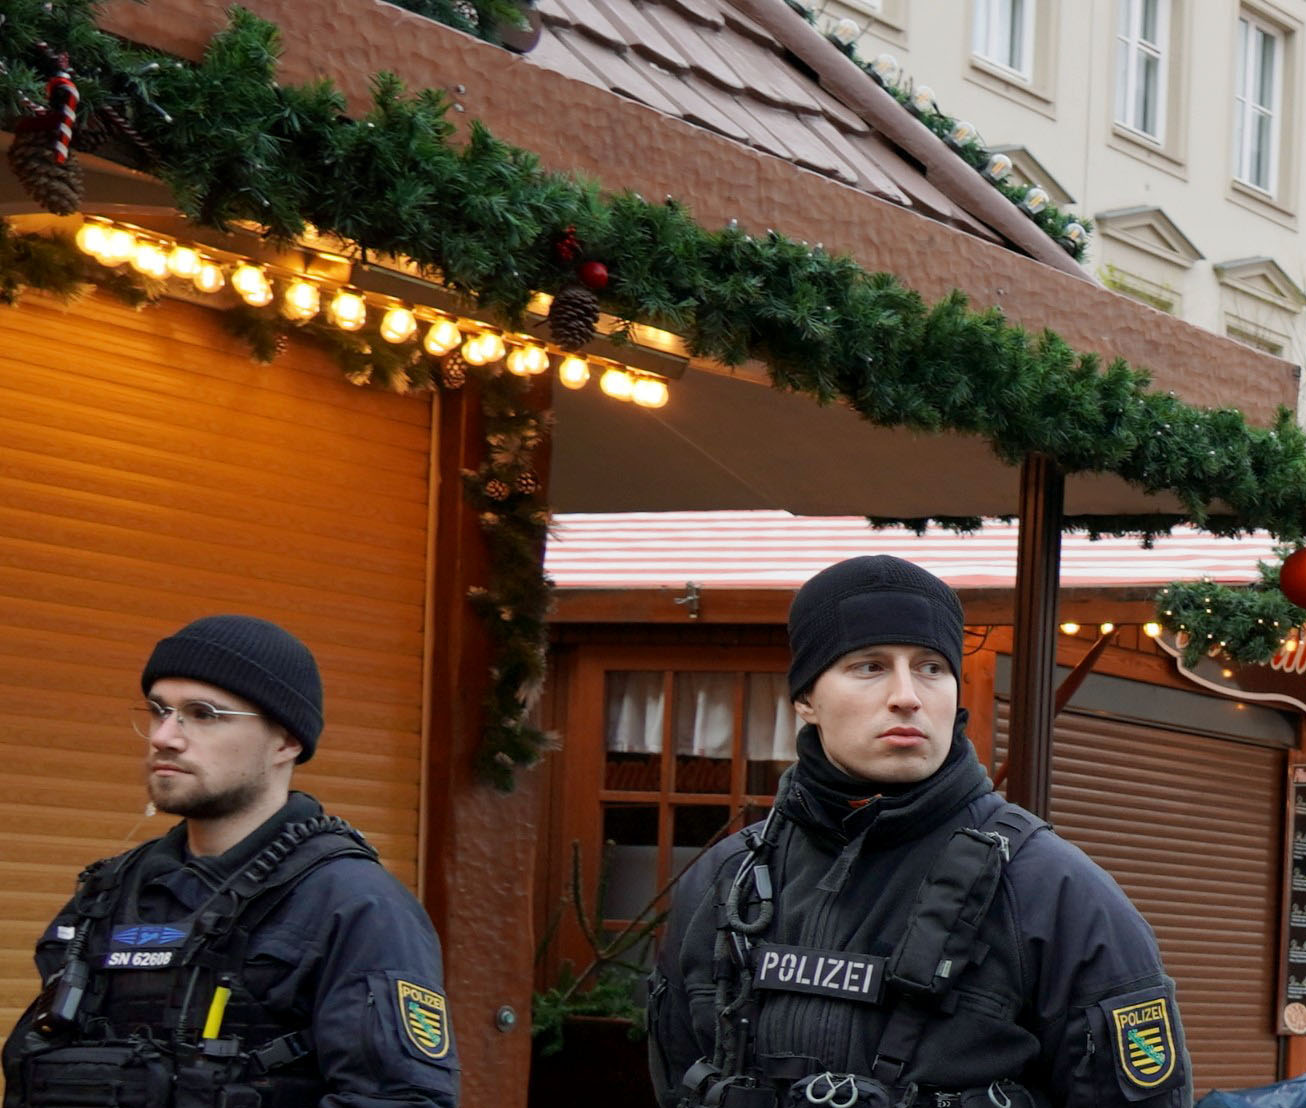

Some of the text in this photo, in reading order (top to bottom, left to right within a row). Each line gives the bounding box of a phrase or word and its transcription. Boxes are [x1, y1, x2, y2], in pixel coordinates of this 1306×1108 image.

[108, 952, 131, 965] SN
[760, 951, 874, 993] POLIZEI
[402, 986, 444, 1010] POLIZEI
[1120, 1005, 1163, 1029] POLIZEI
